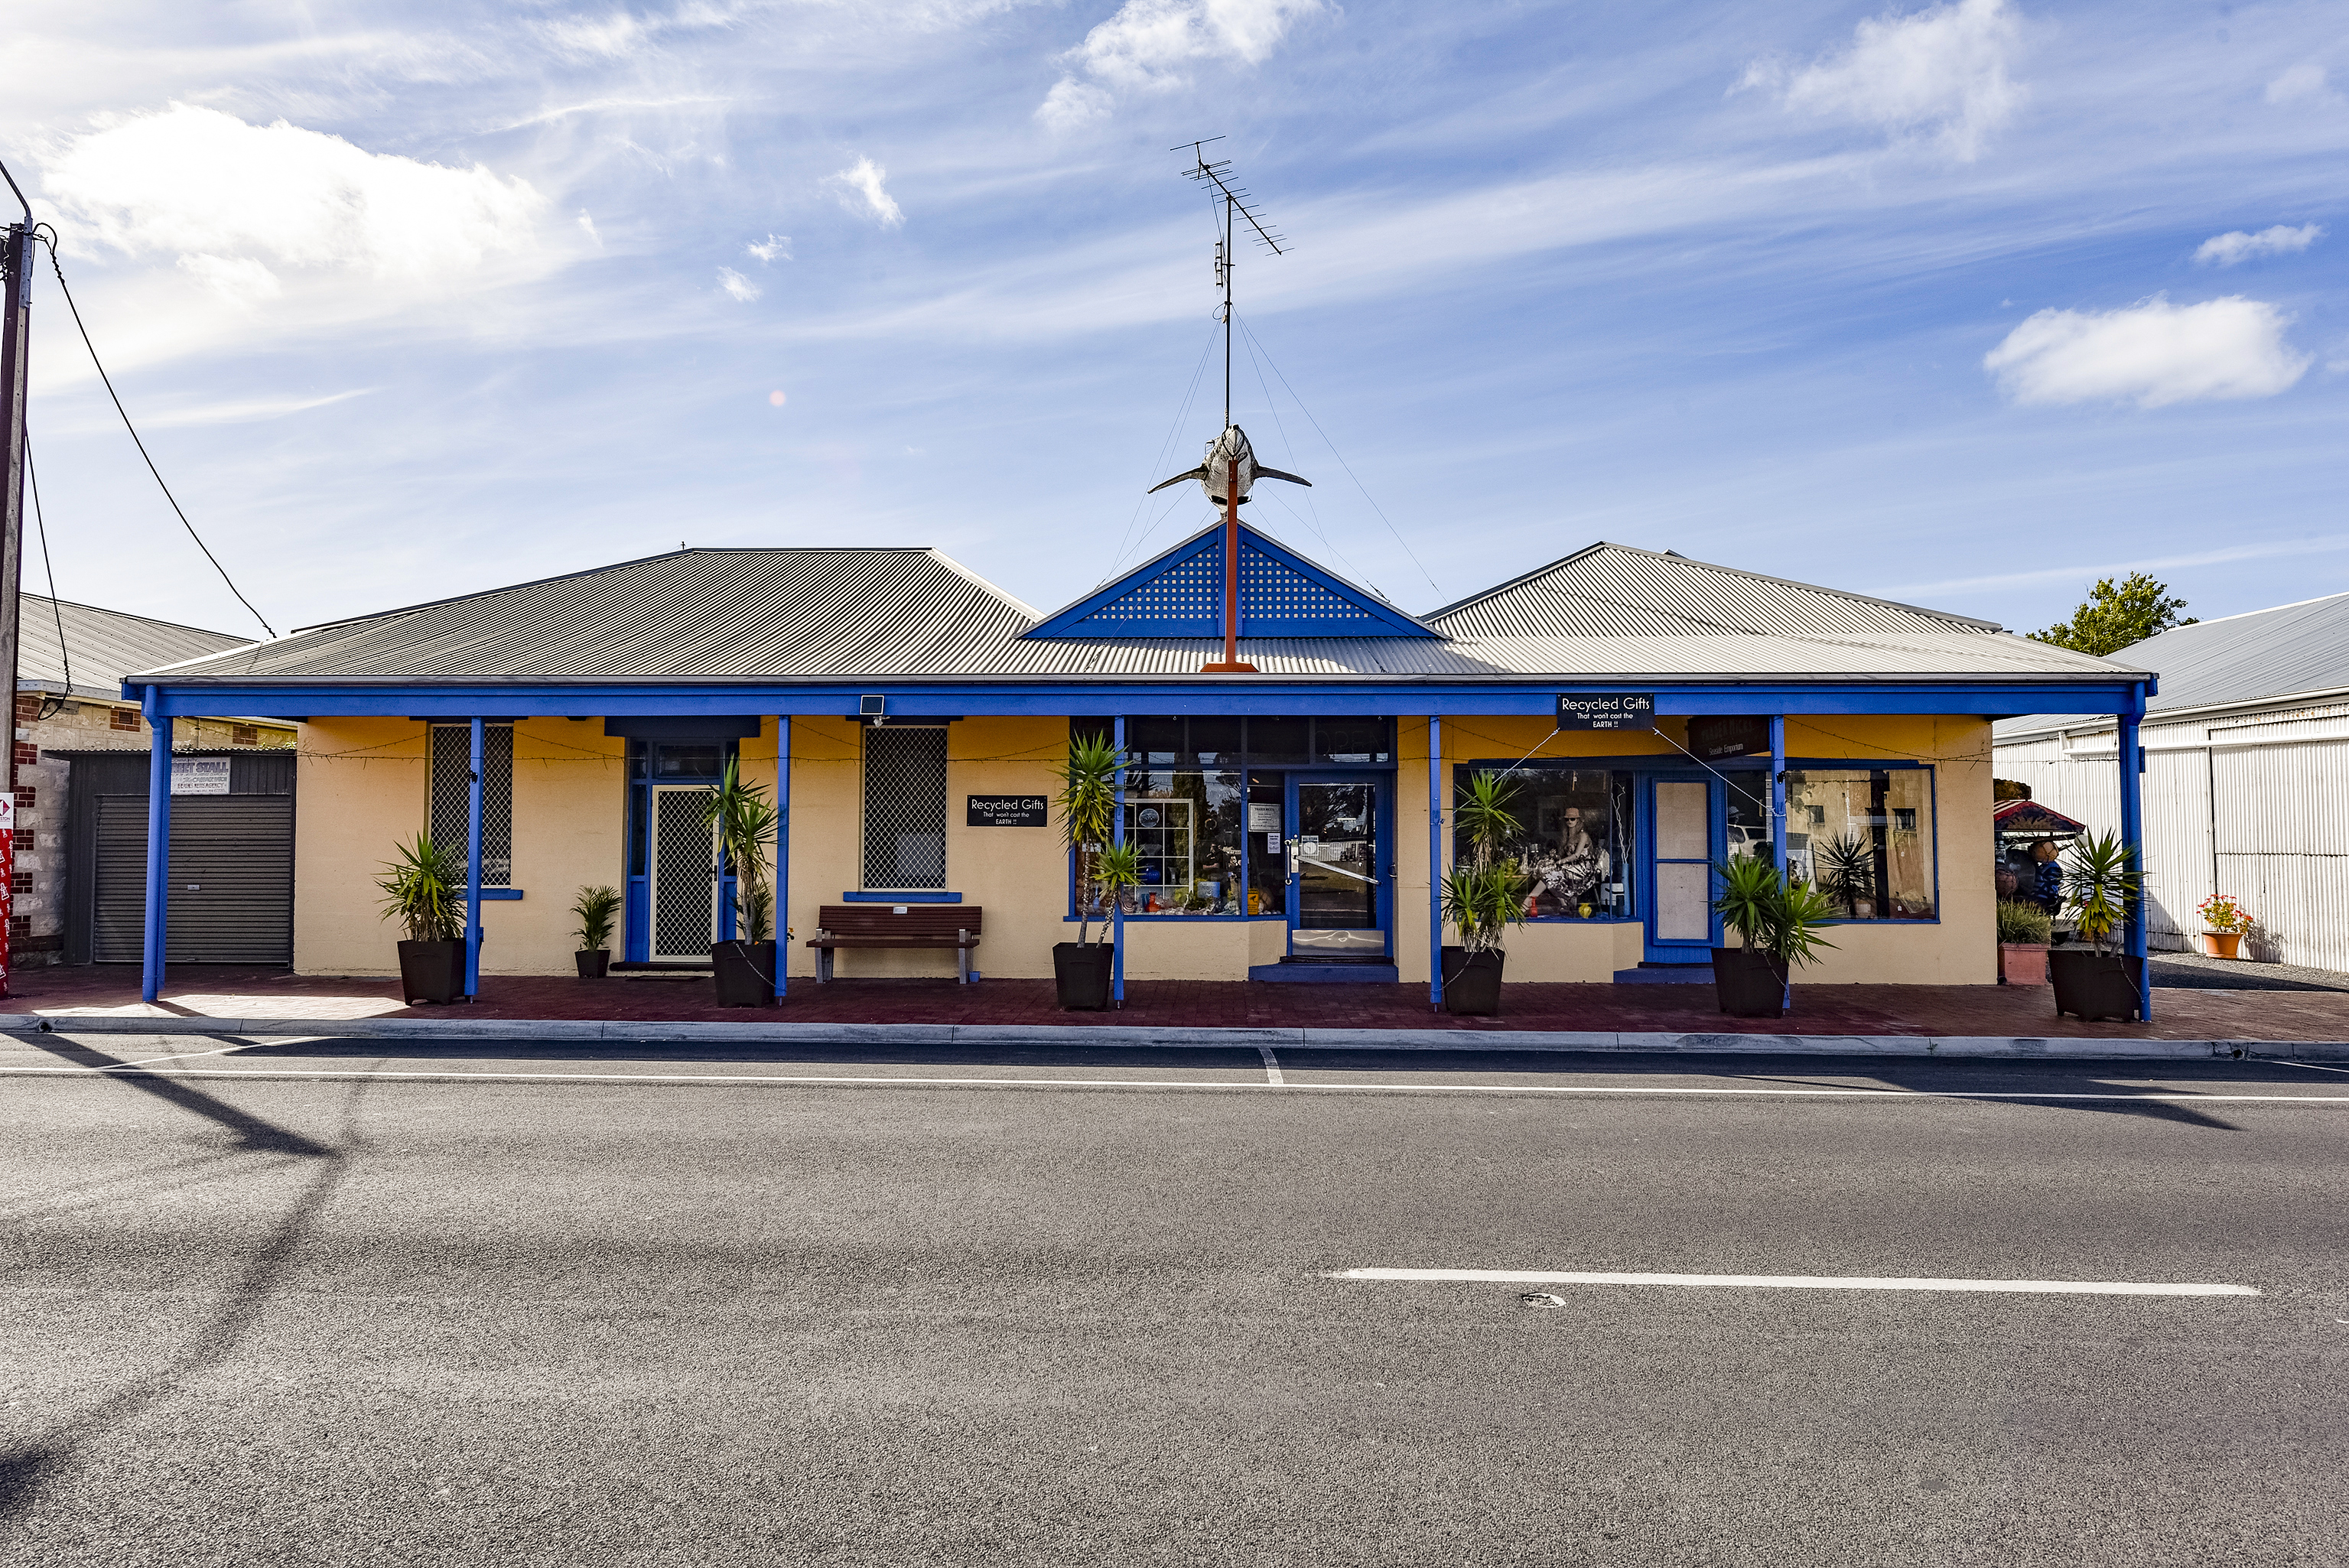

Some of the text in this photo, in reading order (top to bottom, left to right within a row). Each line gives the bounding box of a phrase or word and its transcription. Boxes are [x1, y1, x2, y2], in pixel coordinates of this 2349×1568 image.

[1562, 697, 1650, 713] Recycled Gifts
[1708, 743, 1744, 756] Seaside Emporium
[171, 762, 228, 773] REET STALL
[971, 799, 1044, 812] Recycled Gifts
